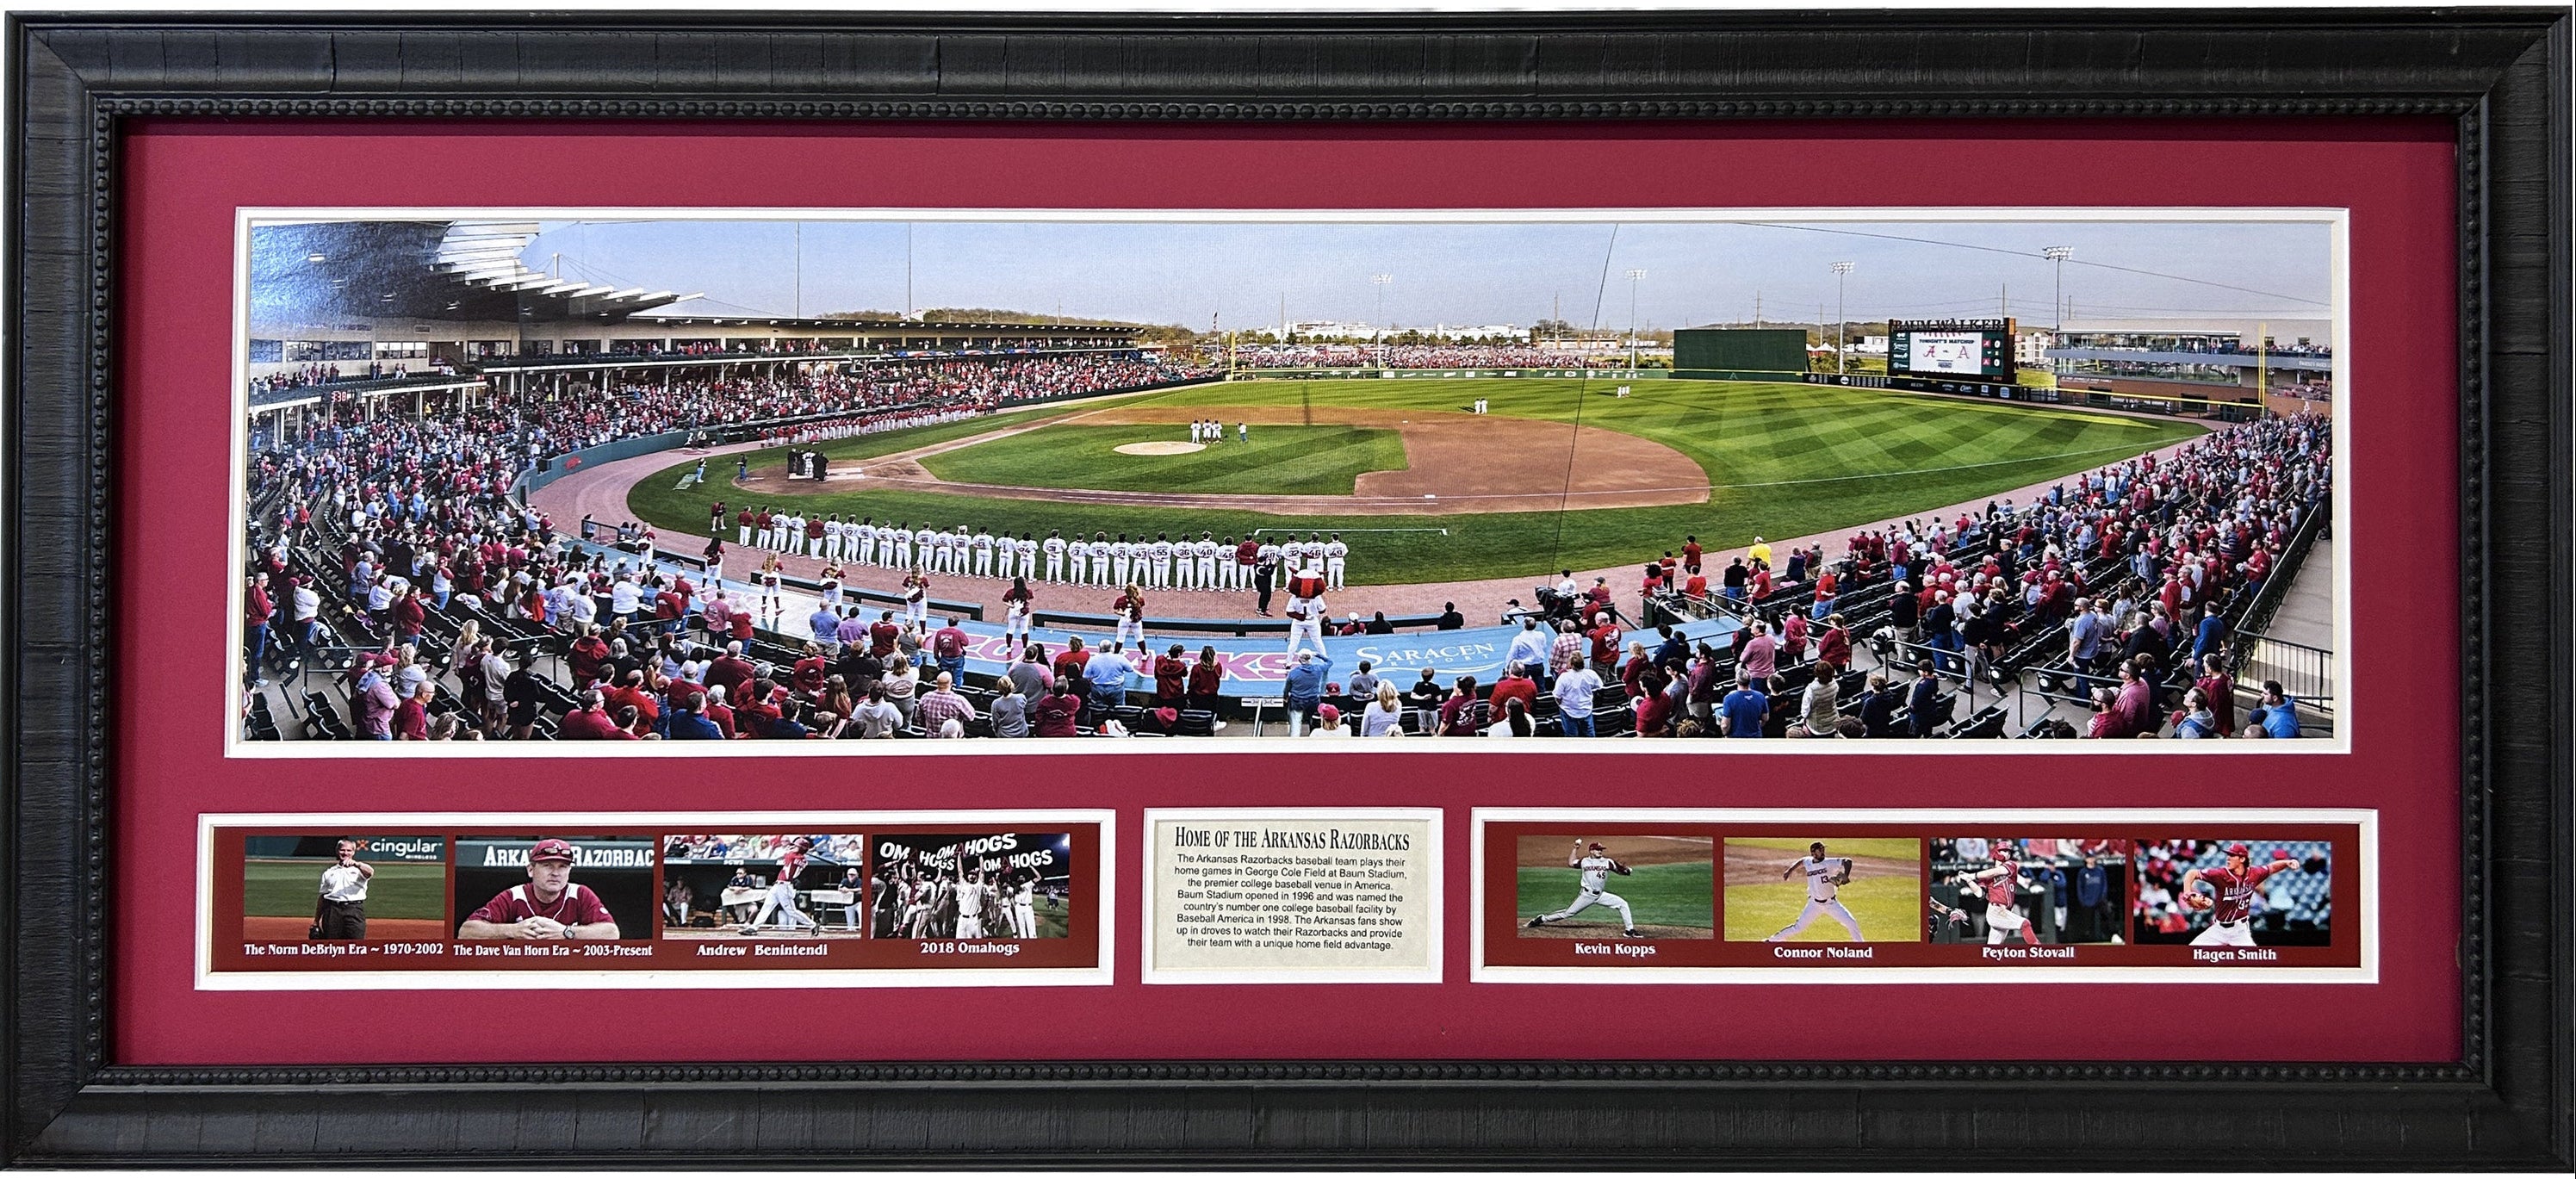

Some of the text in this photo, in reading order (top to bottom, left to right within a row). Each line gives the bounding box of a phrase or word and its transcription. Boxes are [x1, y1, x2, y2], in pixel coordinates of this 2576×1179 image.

[1957, 345, 1971, 360] A
[1356, 642, 1495, 667] SARACEN
[1390, 654, 1490, 667] RESORT
[1174, 825, 1410, 852] HOME OF THE ARKANSAS RAZORBACKS
[370, 838, 438, 858] cingular
[1176, 853, 1406, 869] The Arkansas Razorbacks baseball team plays their
[1174, 866, 1407, 880] home games in George Cole Field at Baum Stadium,
[1187, 877, 1394, 891] the premier college baseball venue in America.
[1177, 889, 1204, 900] Baum
[1206, 890, 1243, 900] Stadium
[1245, 890, 1279, 902] opened
[1281, 890, 1289, 901] in
[1292, 890, 1314, 902] 1996
[1316, 891, 1334, 902] and
[1356, 891, 1387, 903] named
[1388, 892, 1404, 903] the
[1182, 901, 1398, 917] country's number one college baseball facility by
[1176, 913, 1404, 927] Baseball America in 1998. The Arkansas fans show
[1176, 925, 1403, 940] up in droves to watch their Razorbacks and provide
[244, 943, 266, 955] The
[268, 944, 299, 955] Norm
[301, 943, 345, 959] DeBriyn
[348, 943, 368, 955] Era
[383, 942, 444, 955] 1970-2002
[452, 944, 473, 956] The
[475, 944, 500, 956] Dave
[502, 944, 522, 956] Van
[524, 944, 549, 957] Horn
[552, 945, 570, 957] Era
[583, 944, 653, 957] 2003-Present
[696, 943, 828, 956] Andrew Benintendi
[920, 942, 1021, 957] 2018 Omahogs
[1187, 937, 1394, 953] their team with a unique home field advantage.
[1574, 942, 1656, 958] Kevin Kopps
[1773, 946, 1873, 959] Connor Noland
[1983, 946, 2075, 961] Peyton Stovall
[2193, 948, 2277, 963] Hagen Smith
